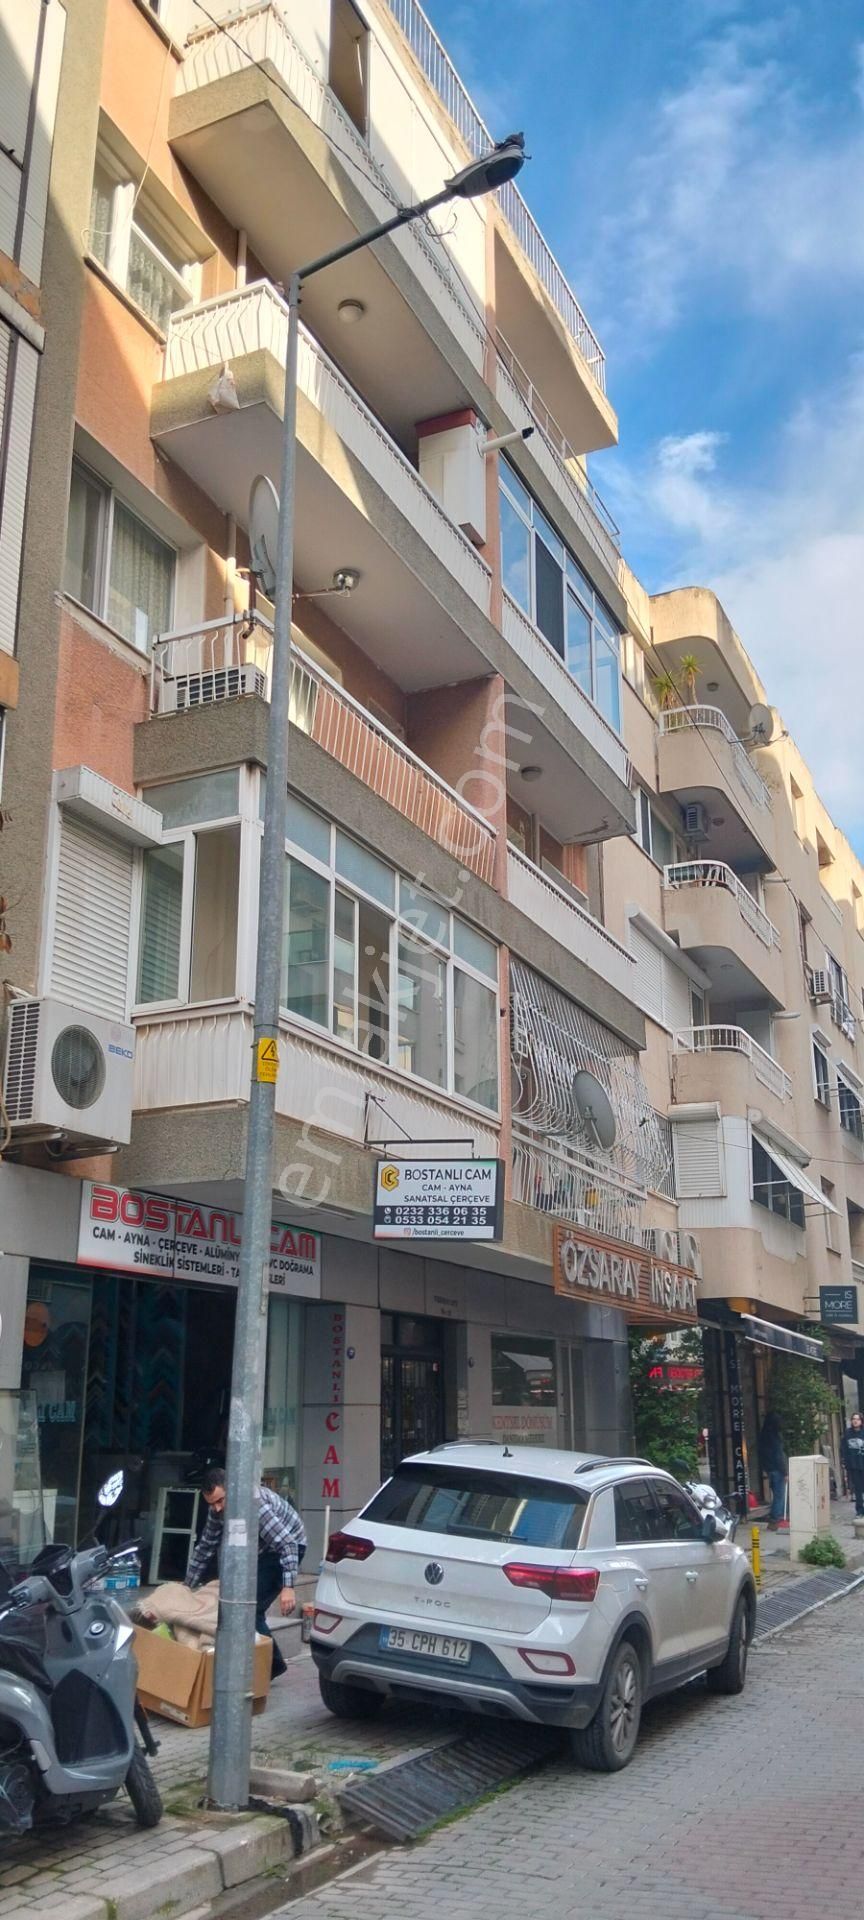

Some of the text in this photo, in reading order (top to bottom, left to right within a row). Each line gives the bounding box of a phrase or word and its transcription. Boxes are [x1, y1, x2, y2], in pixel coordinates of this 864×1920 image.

[108, 1043, 133, 1059] BEKO
[404, 1169, 491, 1180] BOSTANLI CAM
[422, 1184, 441, 1192] CAM
[448, 1184, 472, 1192] AYNA
[404, 1194, 490, 1204] SANATSAL ÇERÇEVE
[90, 1184, 242, 1247] BOSTANL
[395, 1207, 487, 1215] 0232 336 06 35
[395, 1216, 487, 1225] 0533 054 21 35
[92, 1226, 116, 1242] CAM
[123, 1233, 150, 1248] AYNA
[158, 1238, 198, 1257] ÇERÇEVE
[204, 1245, 240, 1262] ALÜMİNY
[279, 1259, 314, 1276] DOĞRAMA
[133, 1248, 175, 1268] SİNEKLİK
[177, 1258, 225, 1277] SİSTEMLERİ
[560, 1230, 698, 1313] ÖZSARAY İNŞAAT
[844, 1290, 853, 1299] IS
[824, 1300, 854, 1310] MORE
[321, 1313, 344, 1498] BOSTANLI CAM
[730, 1385, 741, 1432] MORE
[414, 1595, 452, 1609] T-ROC
[388, 1629, 406, 1648] 35
[411, 1633, 438, 1654] CPH
[442, 1639, 468, 1659] 612
